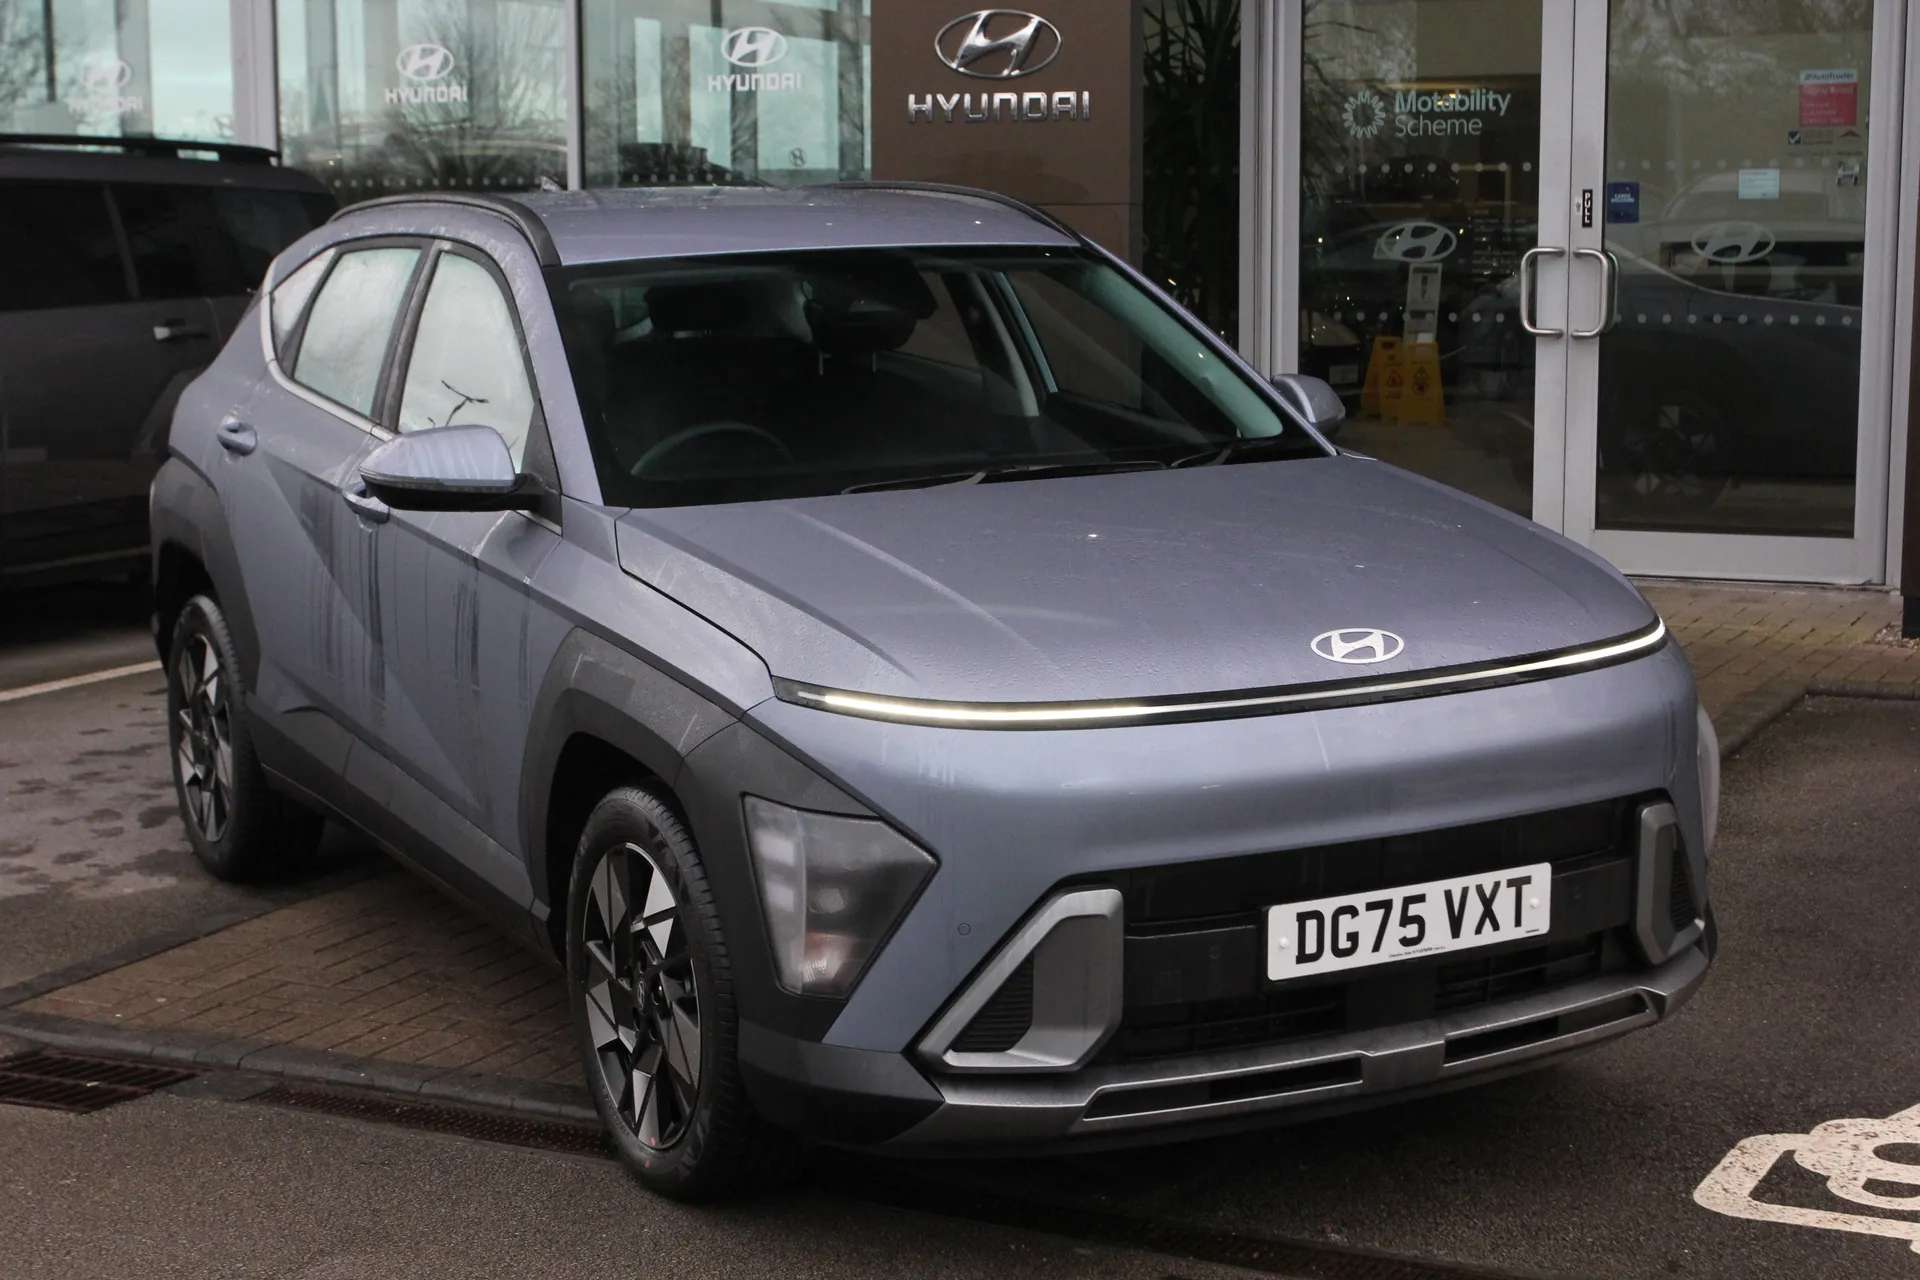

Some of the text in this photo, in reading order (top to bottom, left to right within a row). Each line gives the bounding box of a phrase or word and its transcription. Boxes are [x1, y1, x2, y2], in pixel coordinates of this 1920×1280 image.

[708, 72, 801, 92] HYUNDAI
[385, 85, 467, 104] HYUNDAI
[908, 91, 1090, 122] HYUNDAI
[1395, 90, 1511, 116] Motability
[1395, 115, 1482, 137] Scheme
[1295, 875, 1532, 964] DG75 VXT
